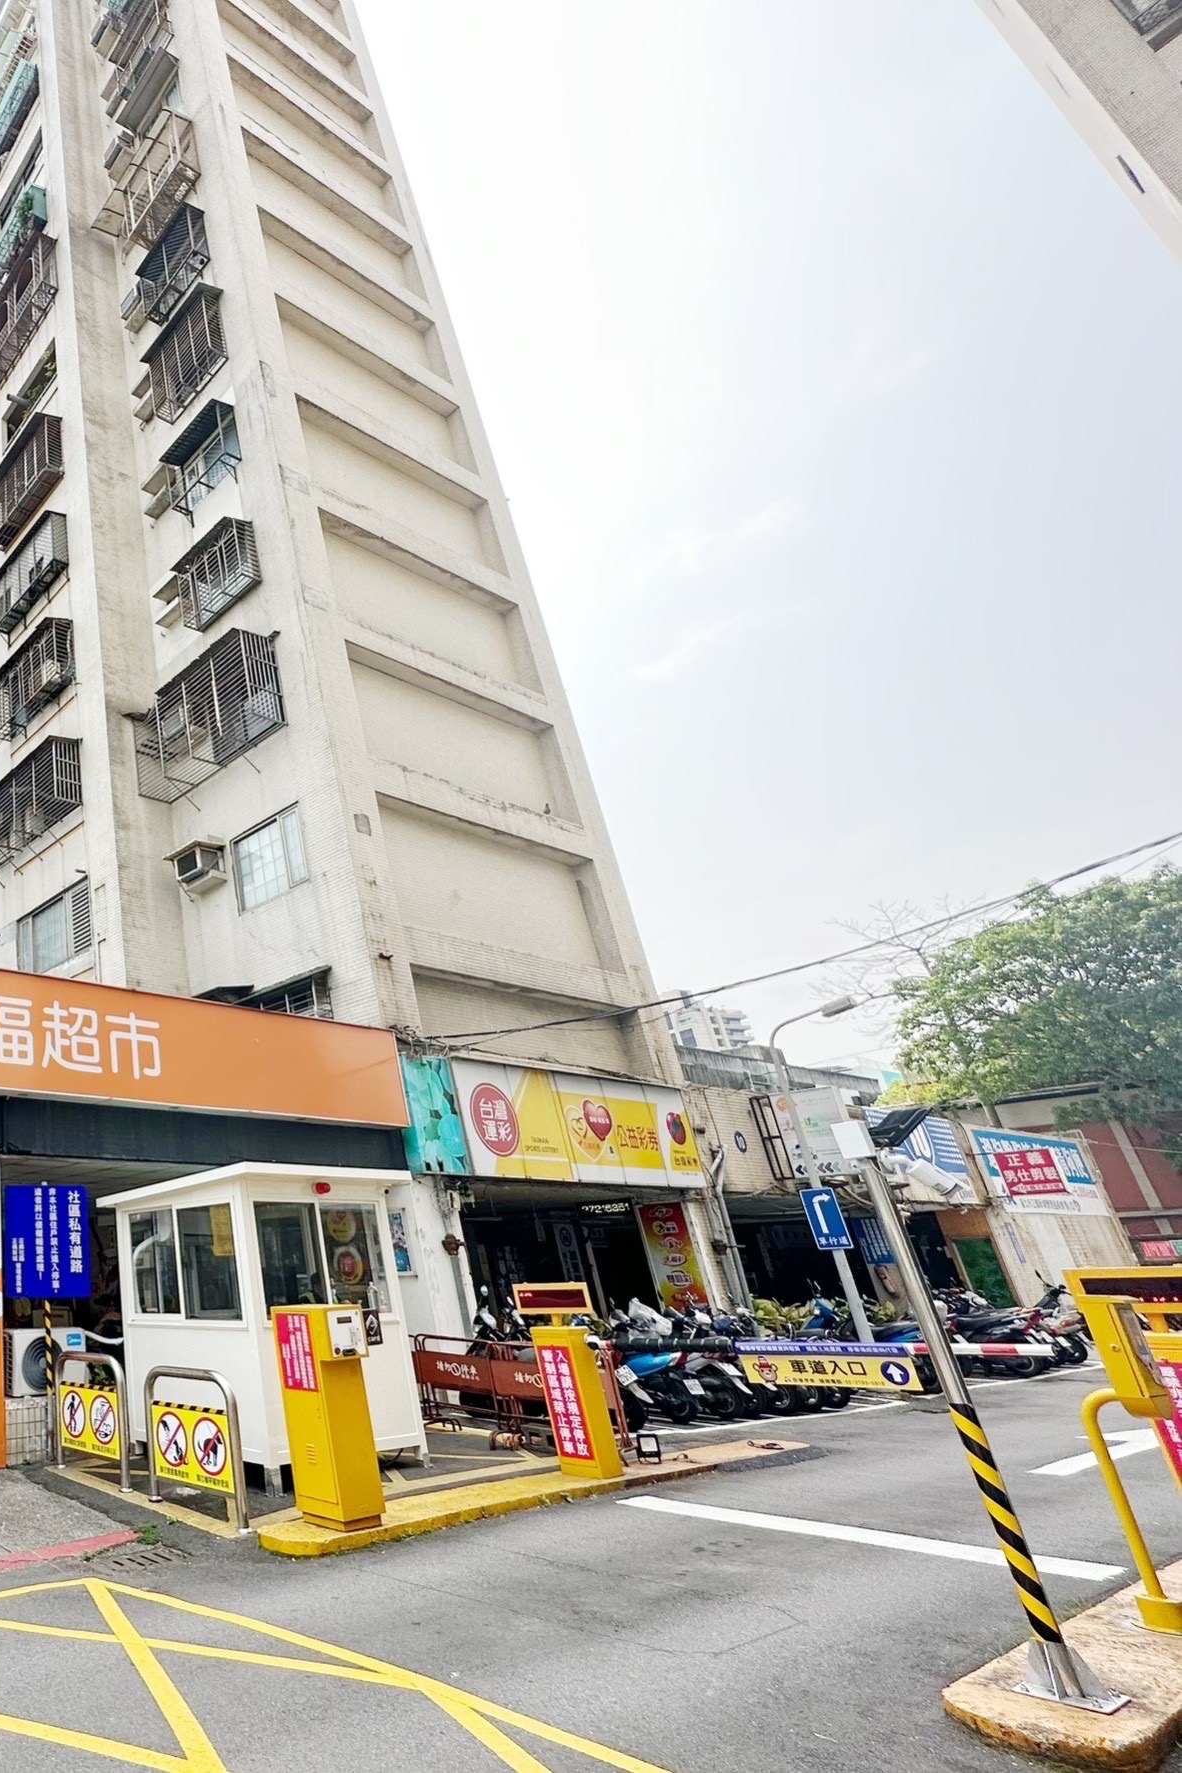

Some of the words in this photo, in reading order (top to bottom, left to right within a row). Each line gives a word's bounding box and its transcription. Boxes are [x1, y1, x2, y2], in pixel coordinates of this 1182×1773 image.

[479, 1098, 508, 1120] 台灣
[482, 1119, 513, 1142] 運彩
[617, 1125, 659, 1151] 公益彩券
[1005, 1151, 1045, 1166] 正義
[1003, 1166, 1059, 1183] 男仕剪髮
[68, 1190, 82, 1273] 社區私有道路
[818, 1236, 849, 1245] 單行道
[789, 1359, 867, 1376] 車道入口
[542, 1349, 576, 1455] 管制區域禁止停車
[556, 1350, 590, 1456] 入場請按規定停放
